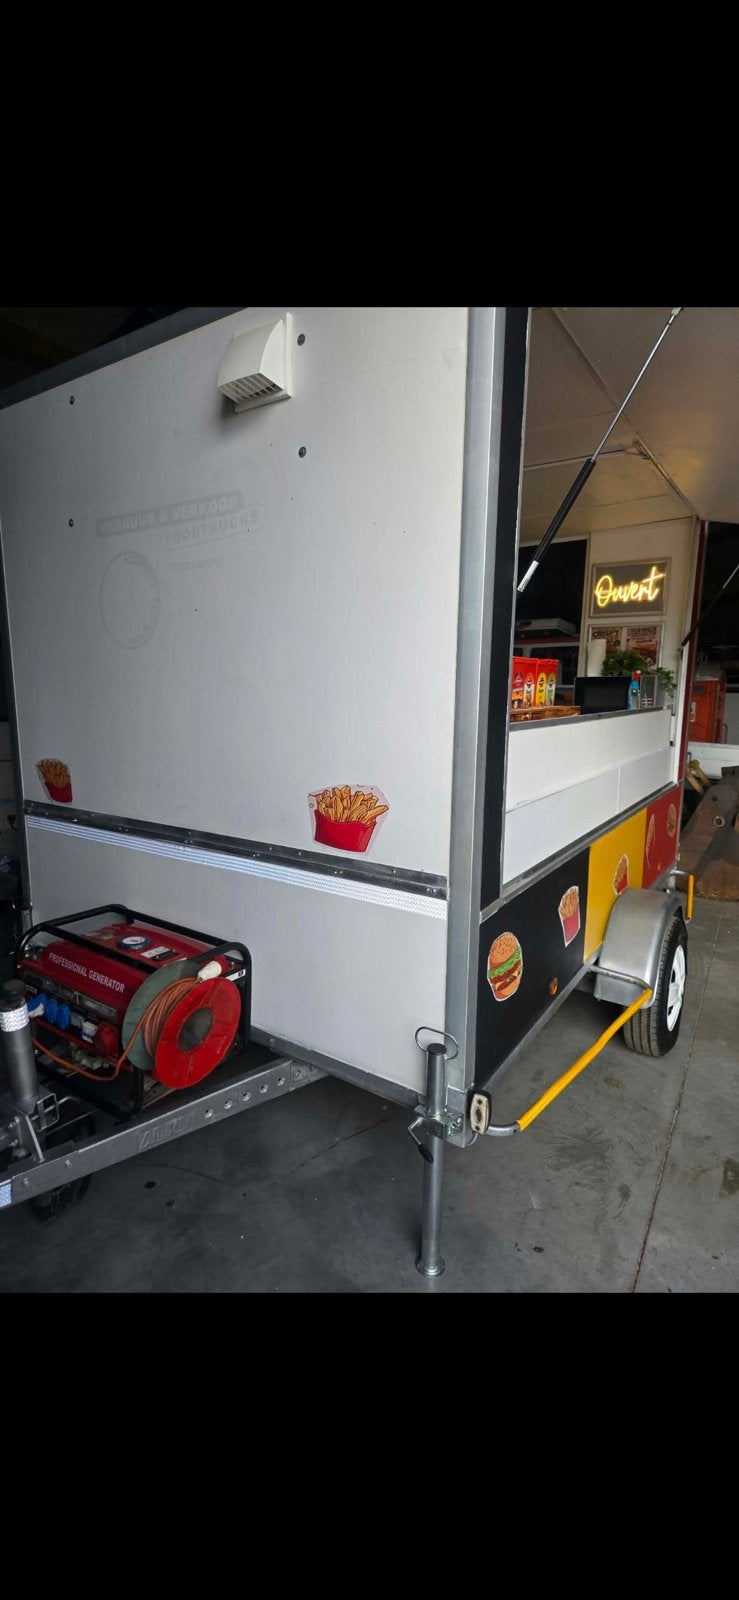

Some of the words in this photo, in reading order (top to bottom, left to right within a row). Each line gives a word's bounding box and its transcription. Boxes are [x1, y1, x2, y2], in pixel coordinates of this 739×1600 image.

[173, 496, 240, 520] VERKOOP
[164, 510, 261, 545] FOODTRUCKS
[595, 566, 666, 608] Ouvert
[48, 952, 88, 978] PROFESSIONAL
[88, 969, 125, 994] GENERATOR
